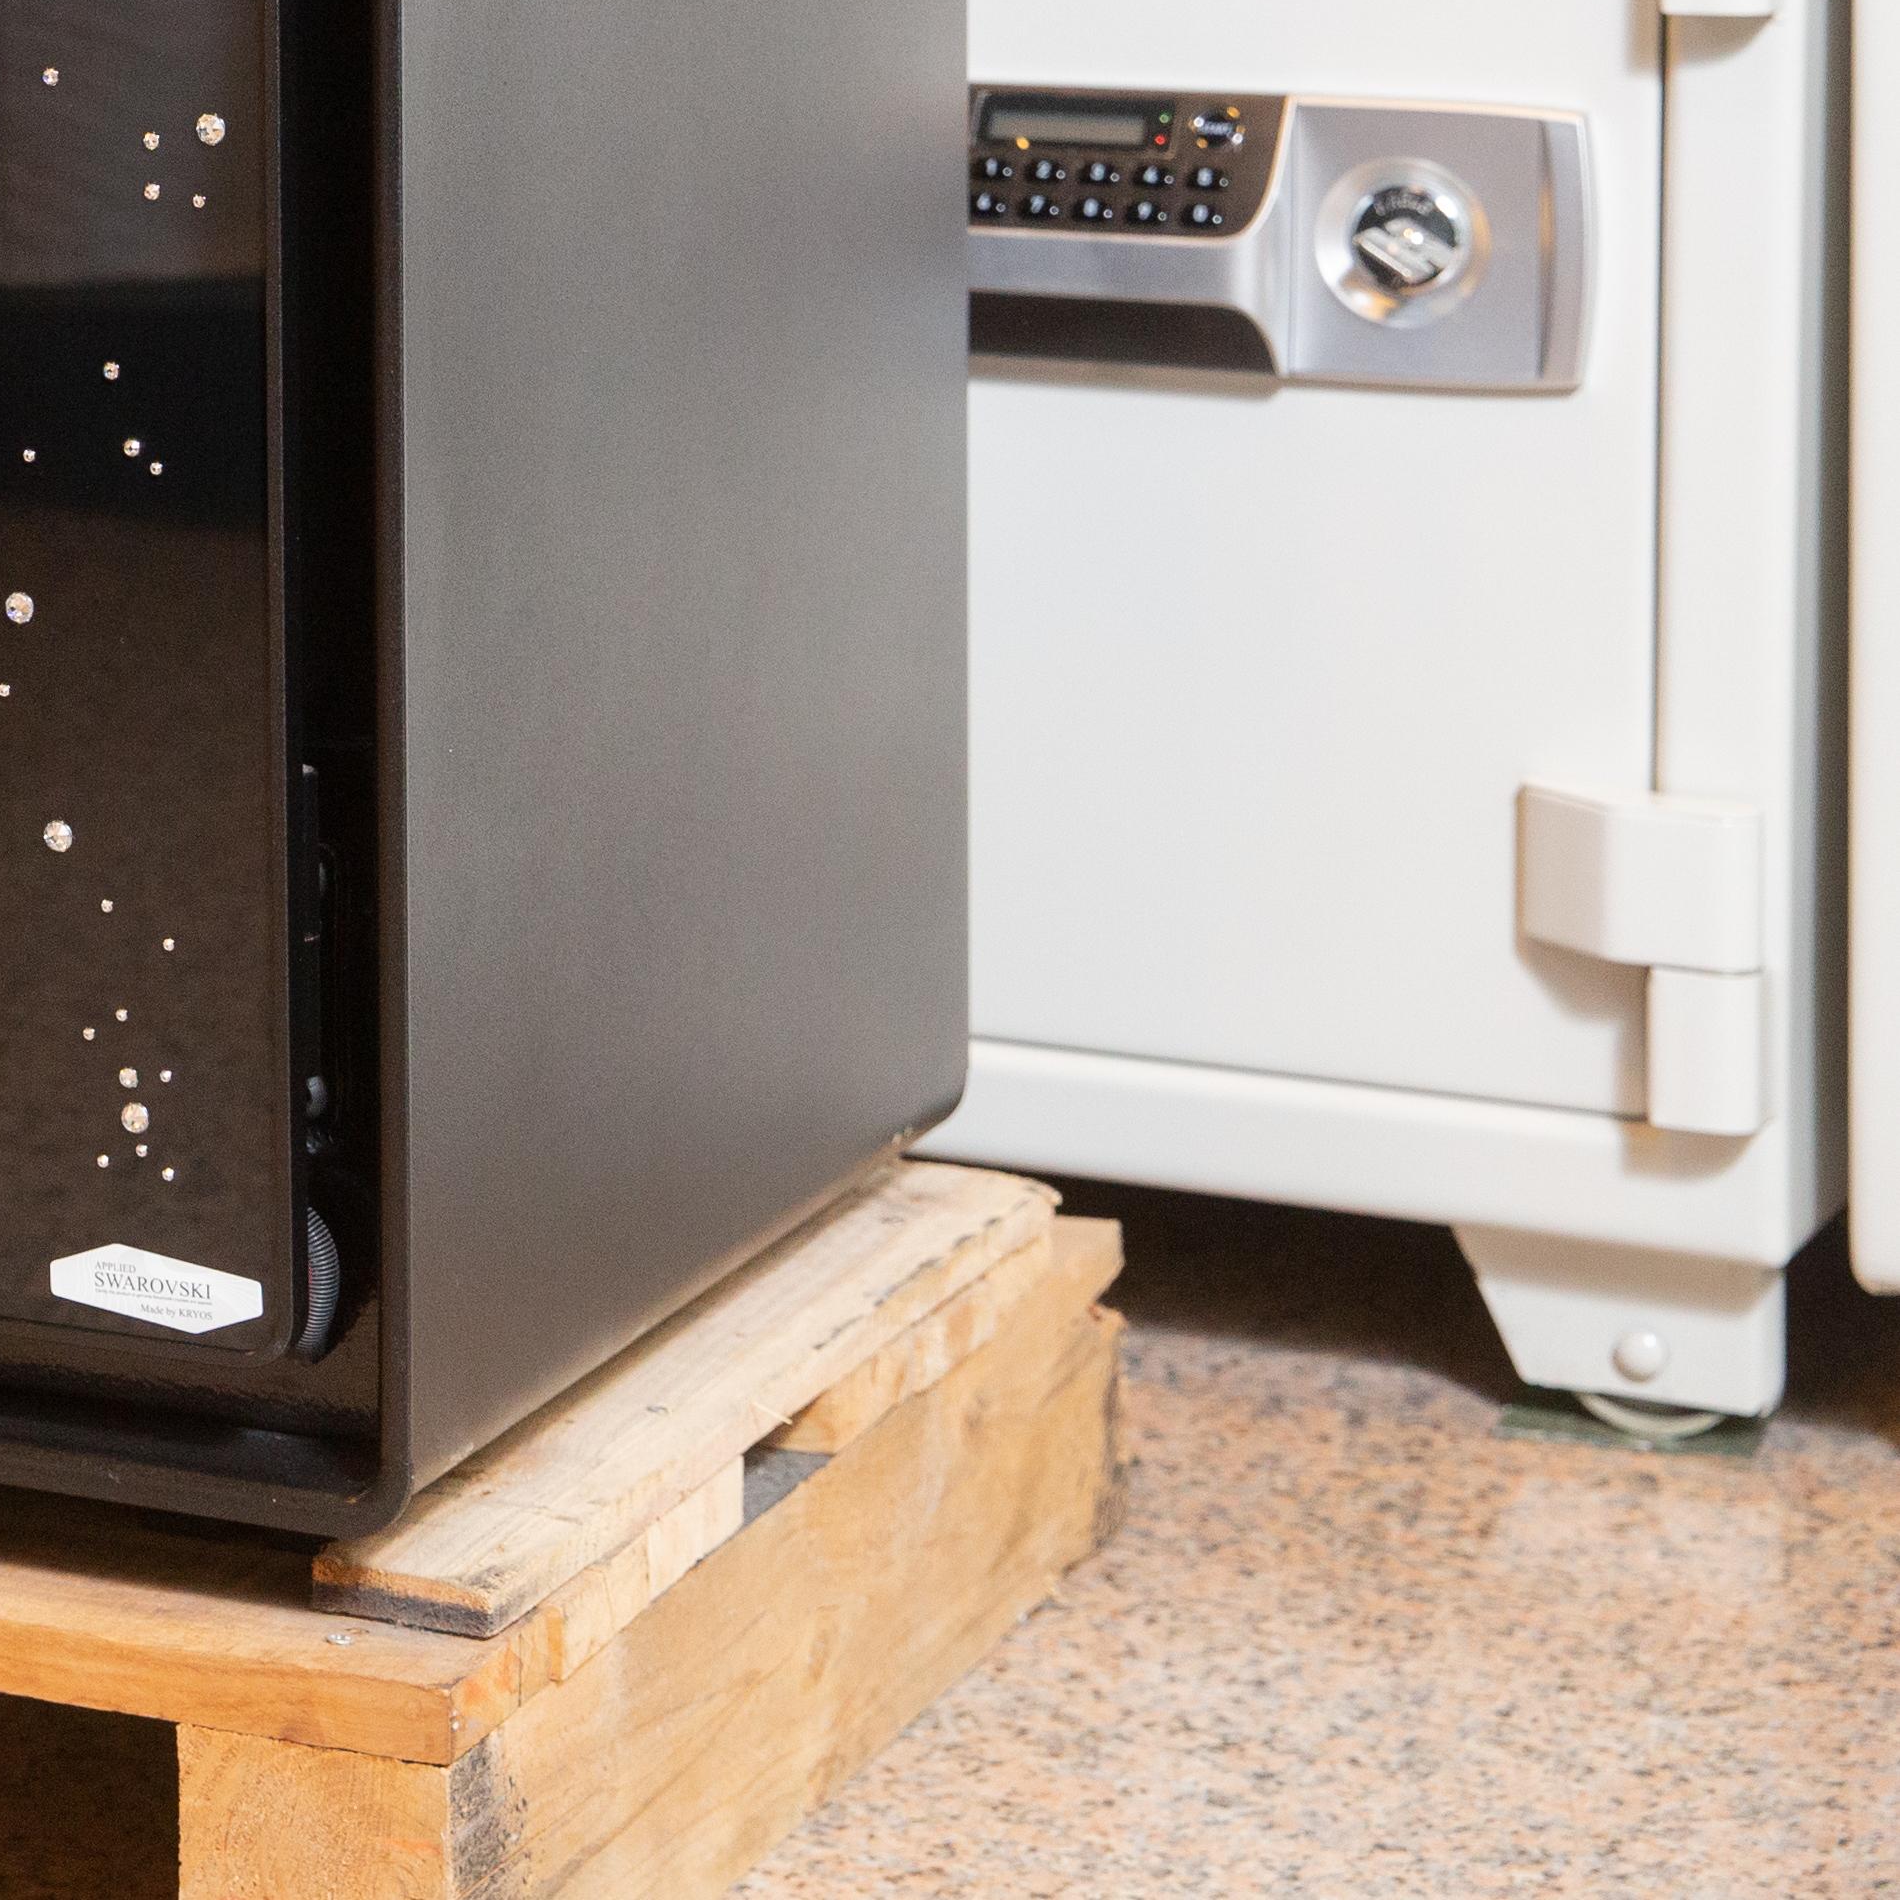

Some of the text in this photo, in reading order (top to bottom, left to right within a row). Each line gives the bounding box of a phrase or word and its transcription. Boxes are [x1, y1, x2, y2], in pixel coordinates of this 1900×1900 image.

[95, 1261, 136, 1274] APPLIED
[95, 1271, 211, 1299] SWAROVSKI
[141, 1304, 213, 1321] Made by KRYOS
